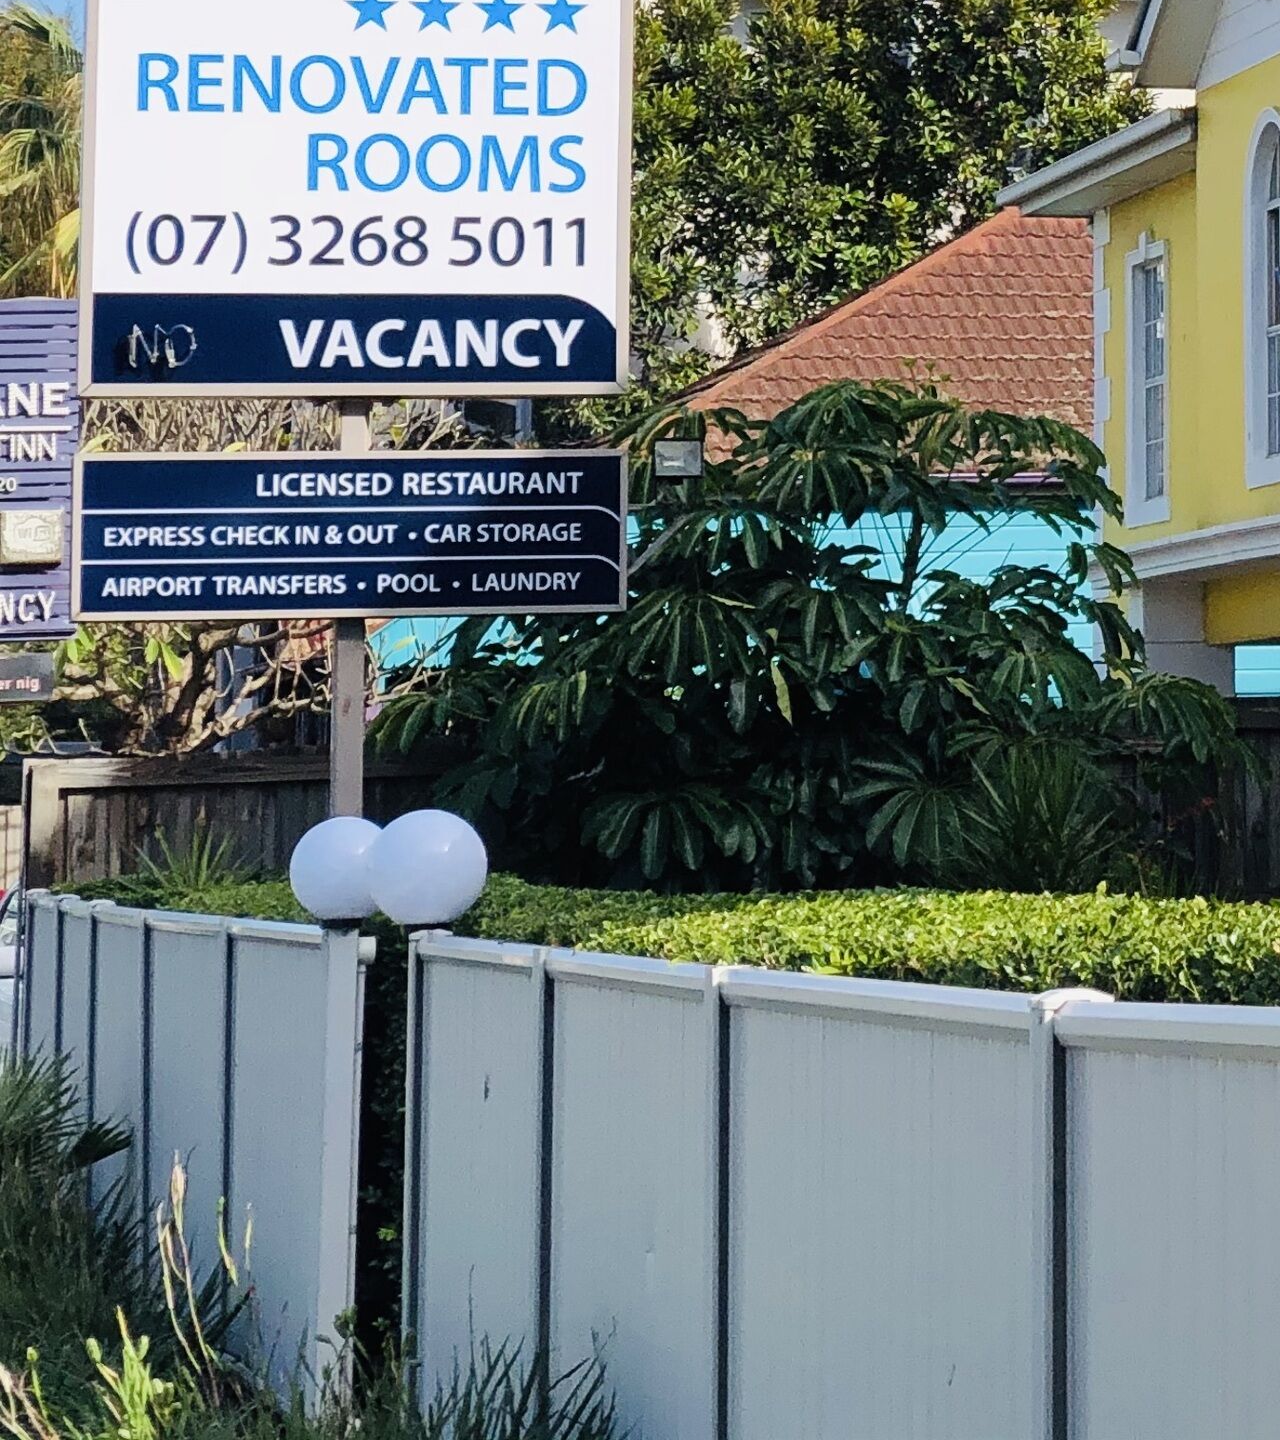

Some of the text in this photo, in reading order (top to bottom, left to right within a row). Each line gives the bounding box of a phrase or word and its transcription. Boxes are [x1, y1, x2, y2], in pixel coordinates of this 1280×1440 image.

[137, 53, 587, 116] RENOVATED
[307, 134, 586, 193] ROOMS
[126, 211, 586, 274] (07) 3268 5011
[129, 318, 585, 368] NO VACANCY
[0, 382, 70, 416] NE
[10, 433, 56, 461] INN
[256, 471, 583, 497] LICENSED RESTAURANT
[104, 523, 581, 547] EXPRESS CHECK IN & OUT CAR STORAGE
[102, 572, 580, 597] AIRPORT TRANSFERS POOL LAUNDRY
